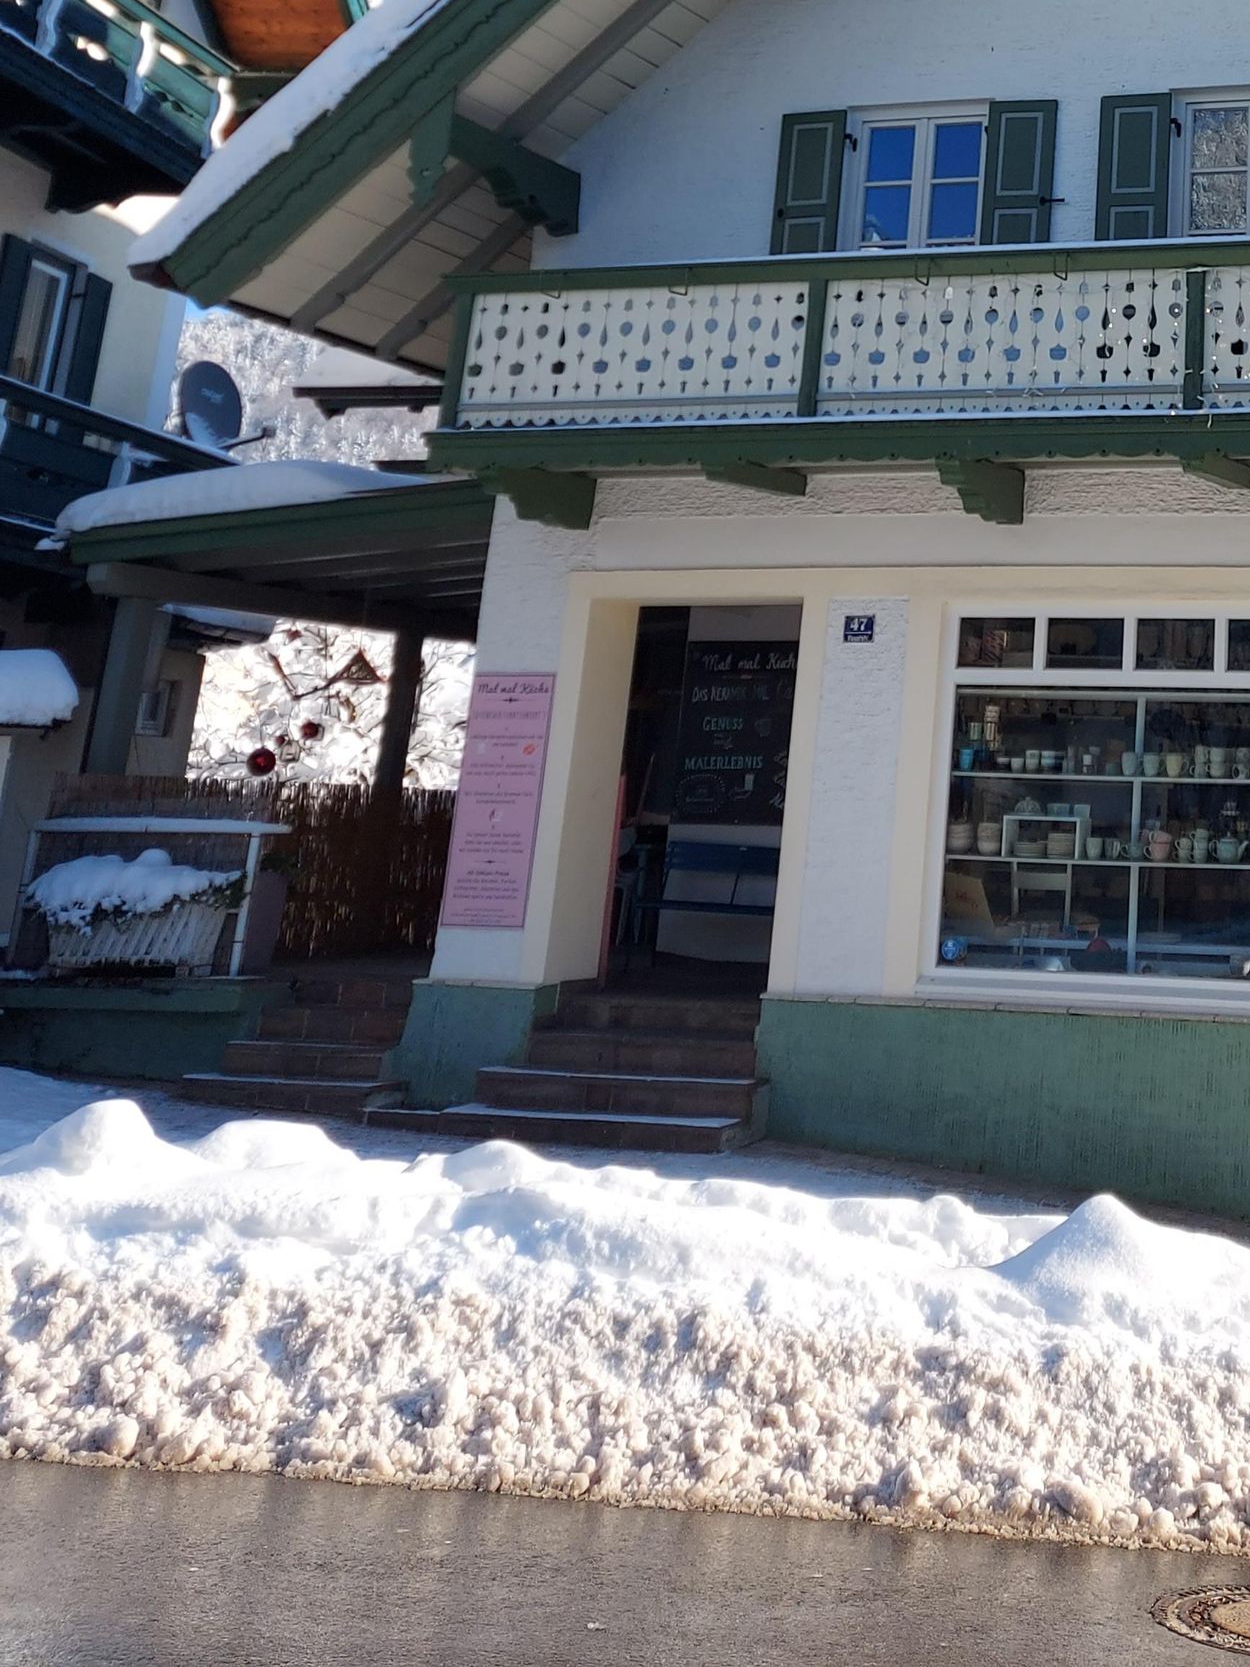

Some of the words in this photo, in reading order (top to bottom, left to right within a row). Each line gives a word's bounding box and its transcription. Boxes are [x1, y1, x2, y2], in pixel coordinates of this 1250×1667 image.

[850, 618, 868, 631] 47
[702, 654, 732, 671] Mal
[478, 682, 499, 694] Mal
[500, 682, 518, 694] mal
[702, 716, 743, 732] GENUSS
[684, 755, 763, 770] MALERLEBNIS
